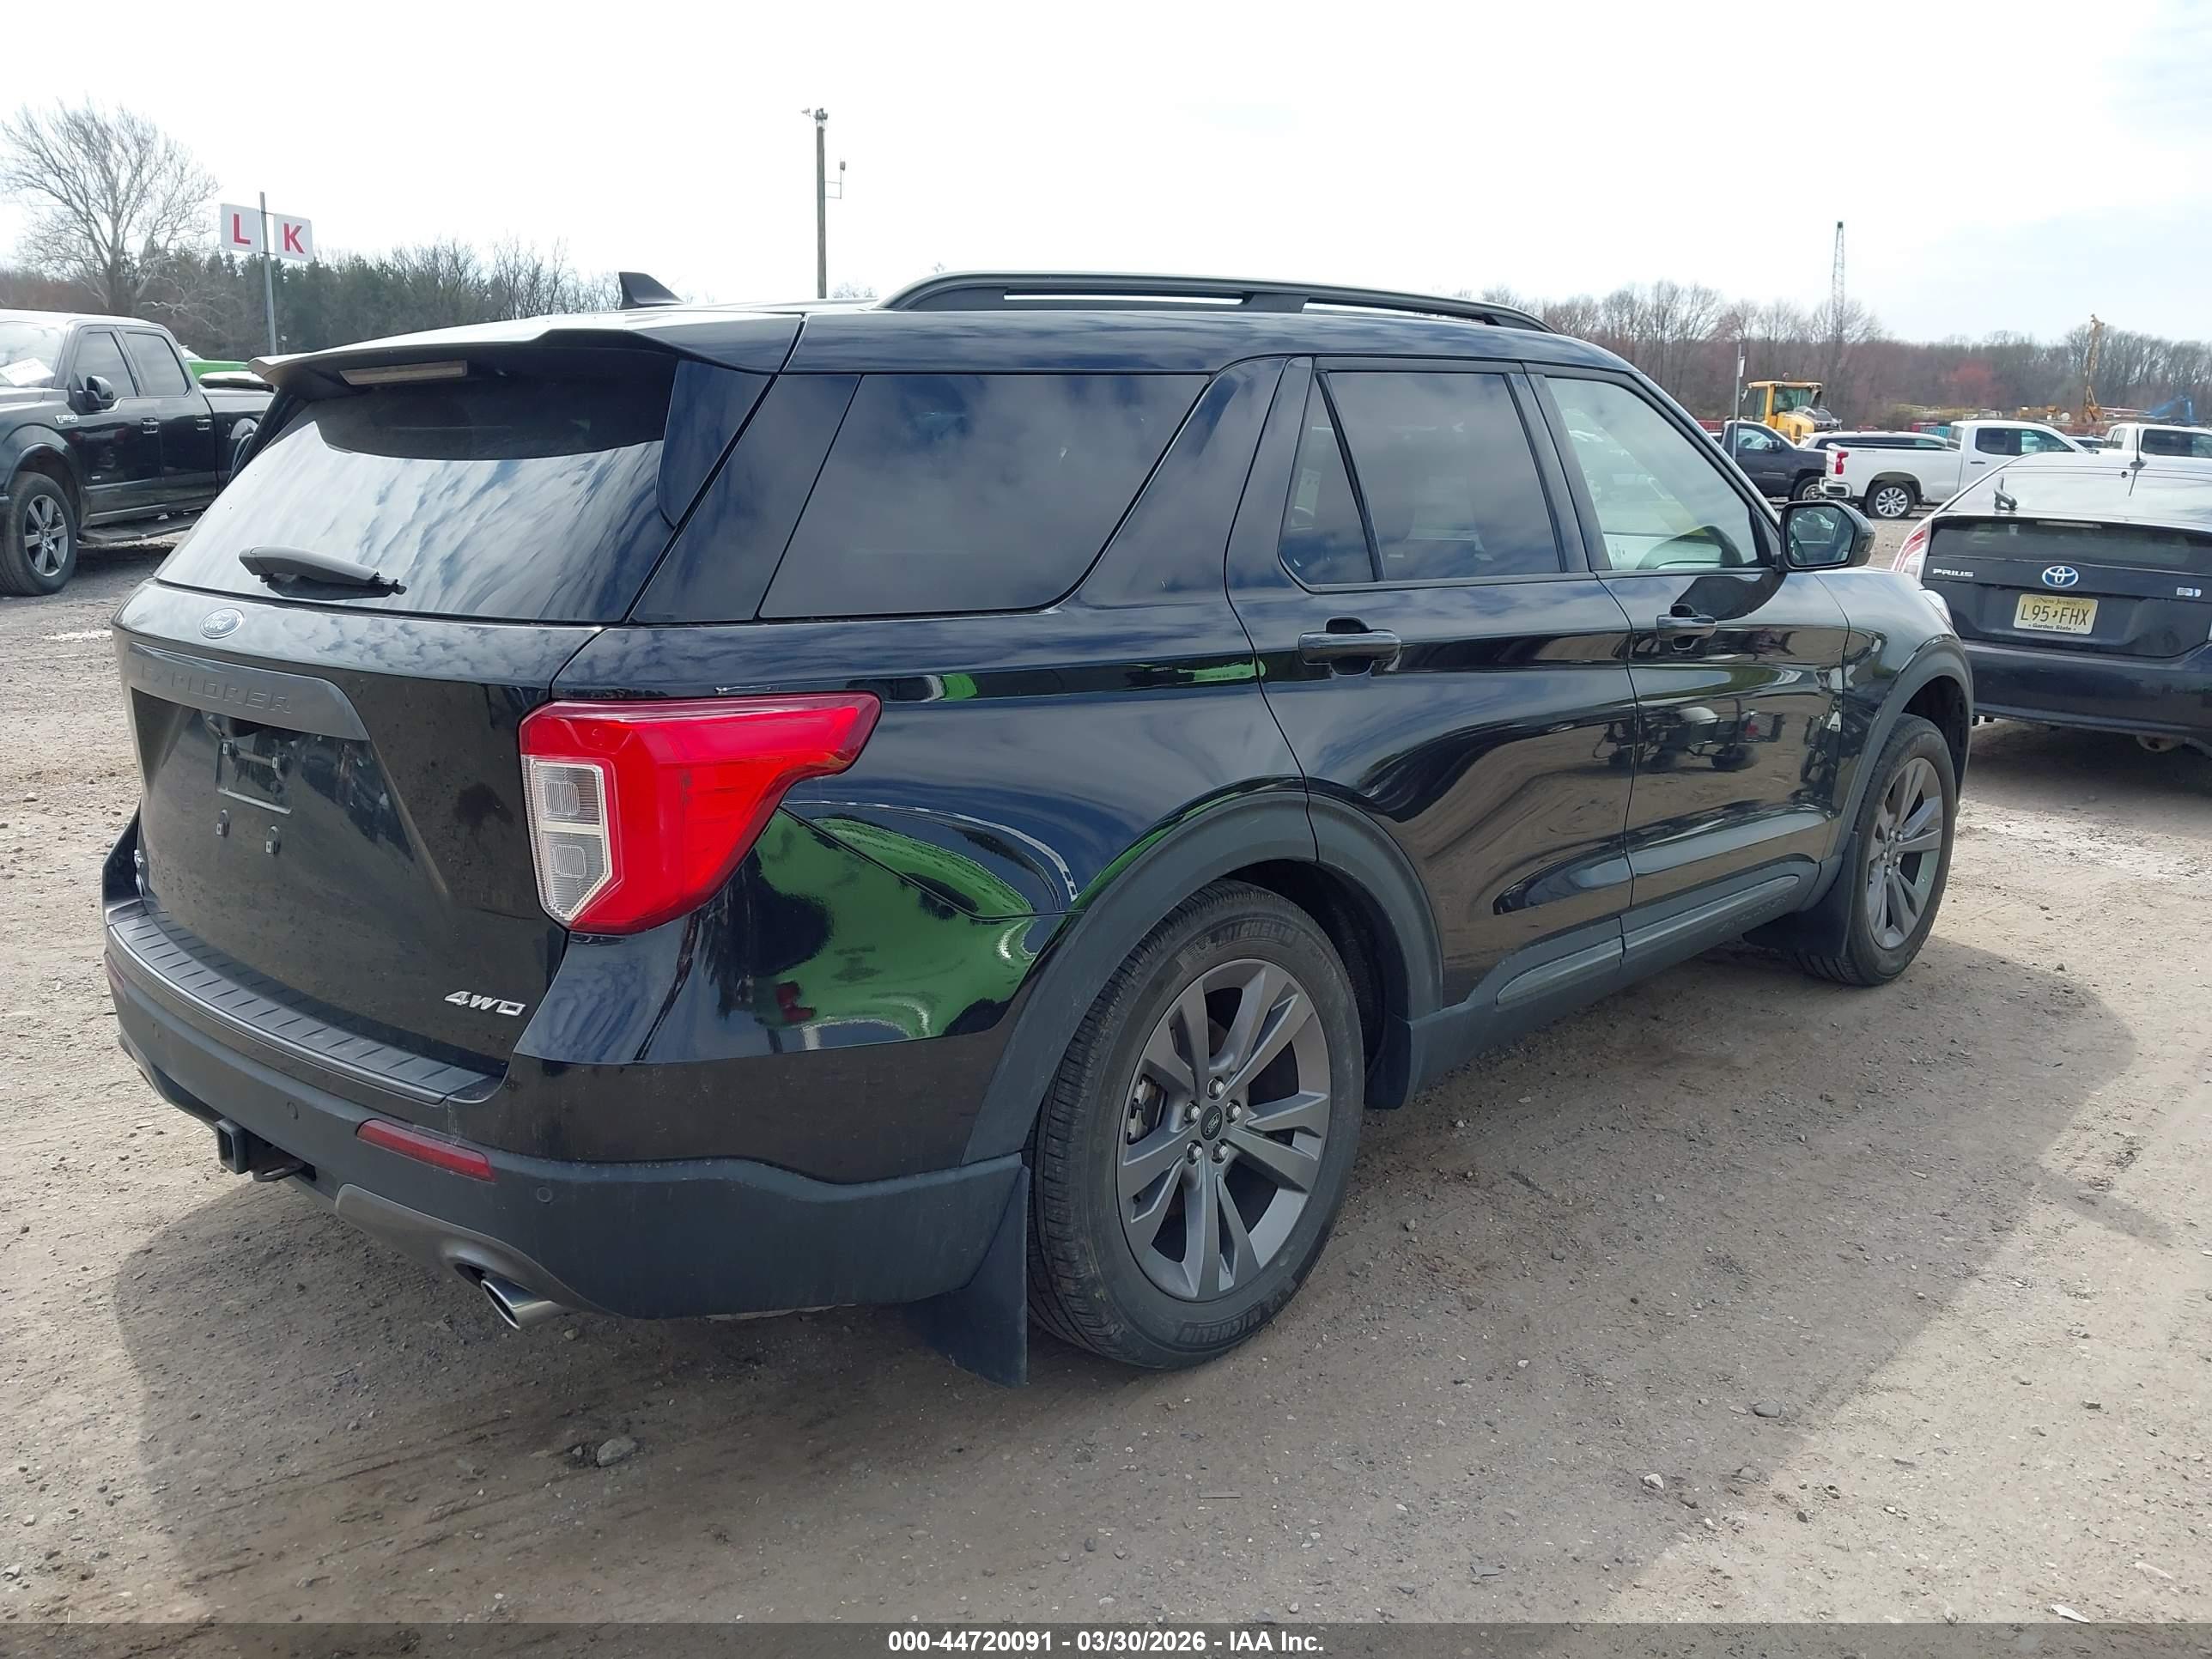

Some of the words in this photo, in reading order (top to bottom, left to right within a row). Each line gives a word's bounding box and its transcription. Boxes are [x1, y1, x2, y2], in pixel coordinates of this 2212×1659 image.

[233, 213, 252, 246] L
[283, 222, 306, 255] K
[1932, 568, 1974, 577] PRIUS
[141, 663, 292, 714] EXPLORER
[1218, 920, 1297, 945] MICHELIN
[444, 990, 526, 1017] 4WD
